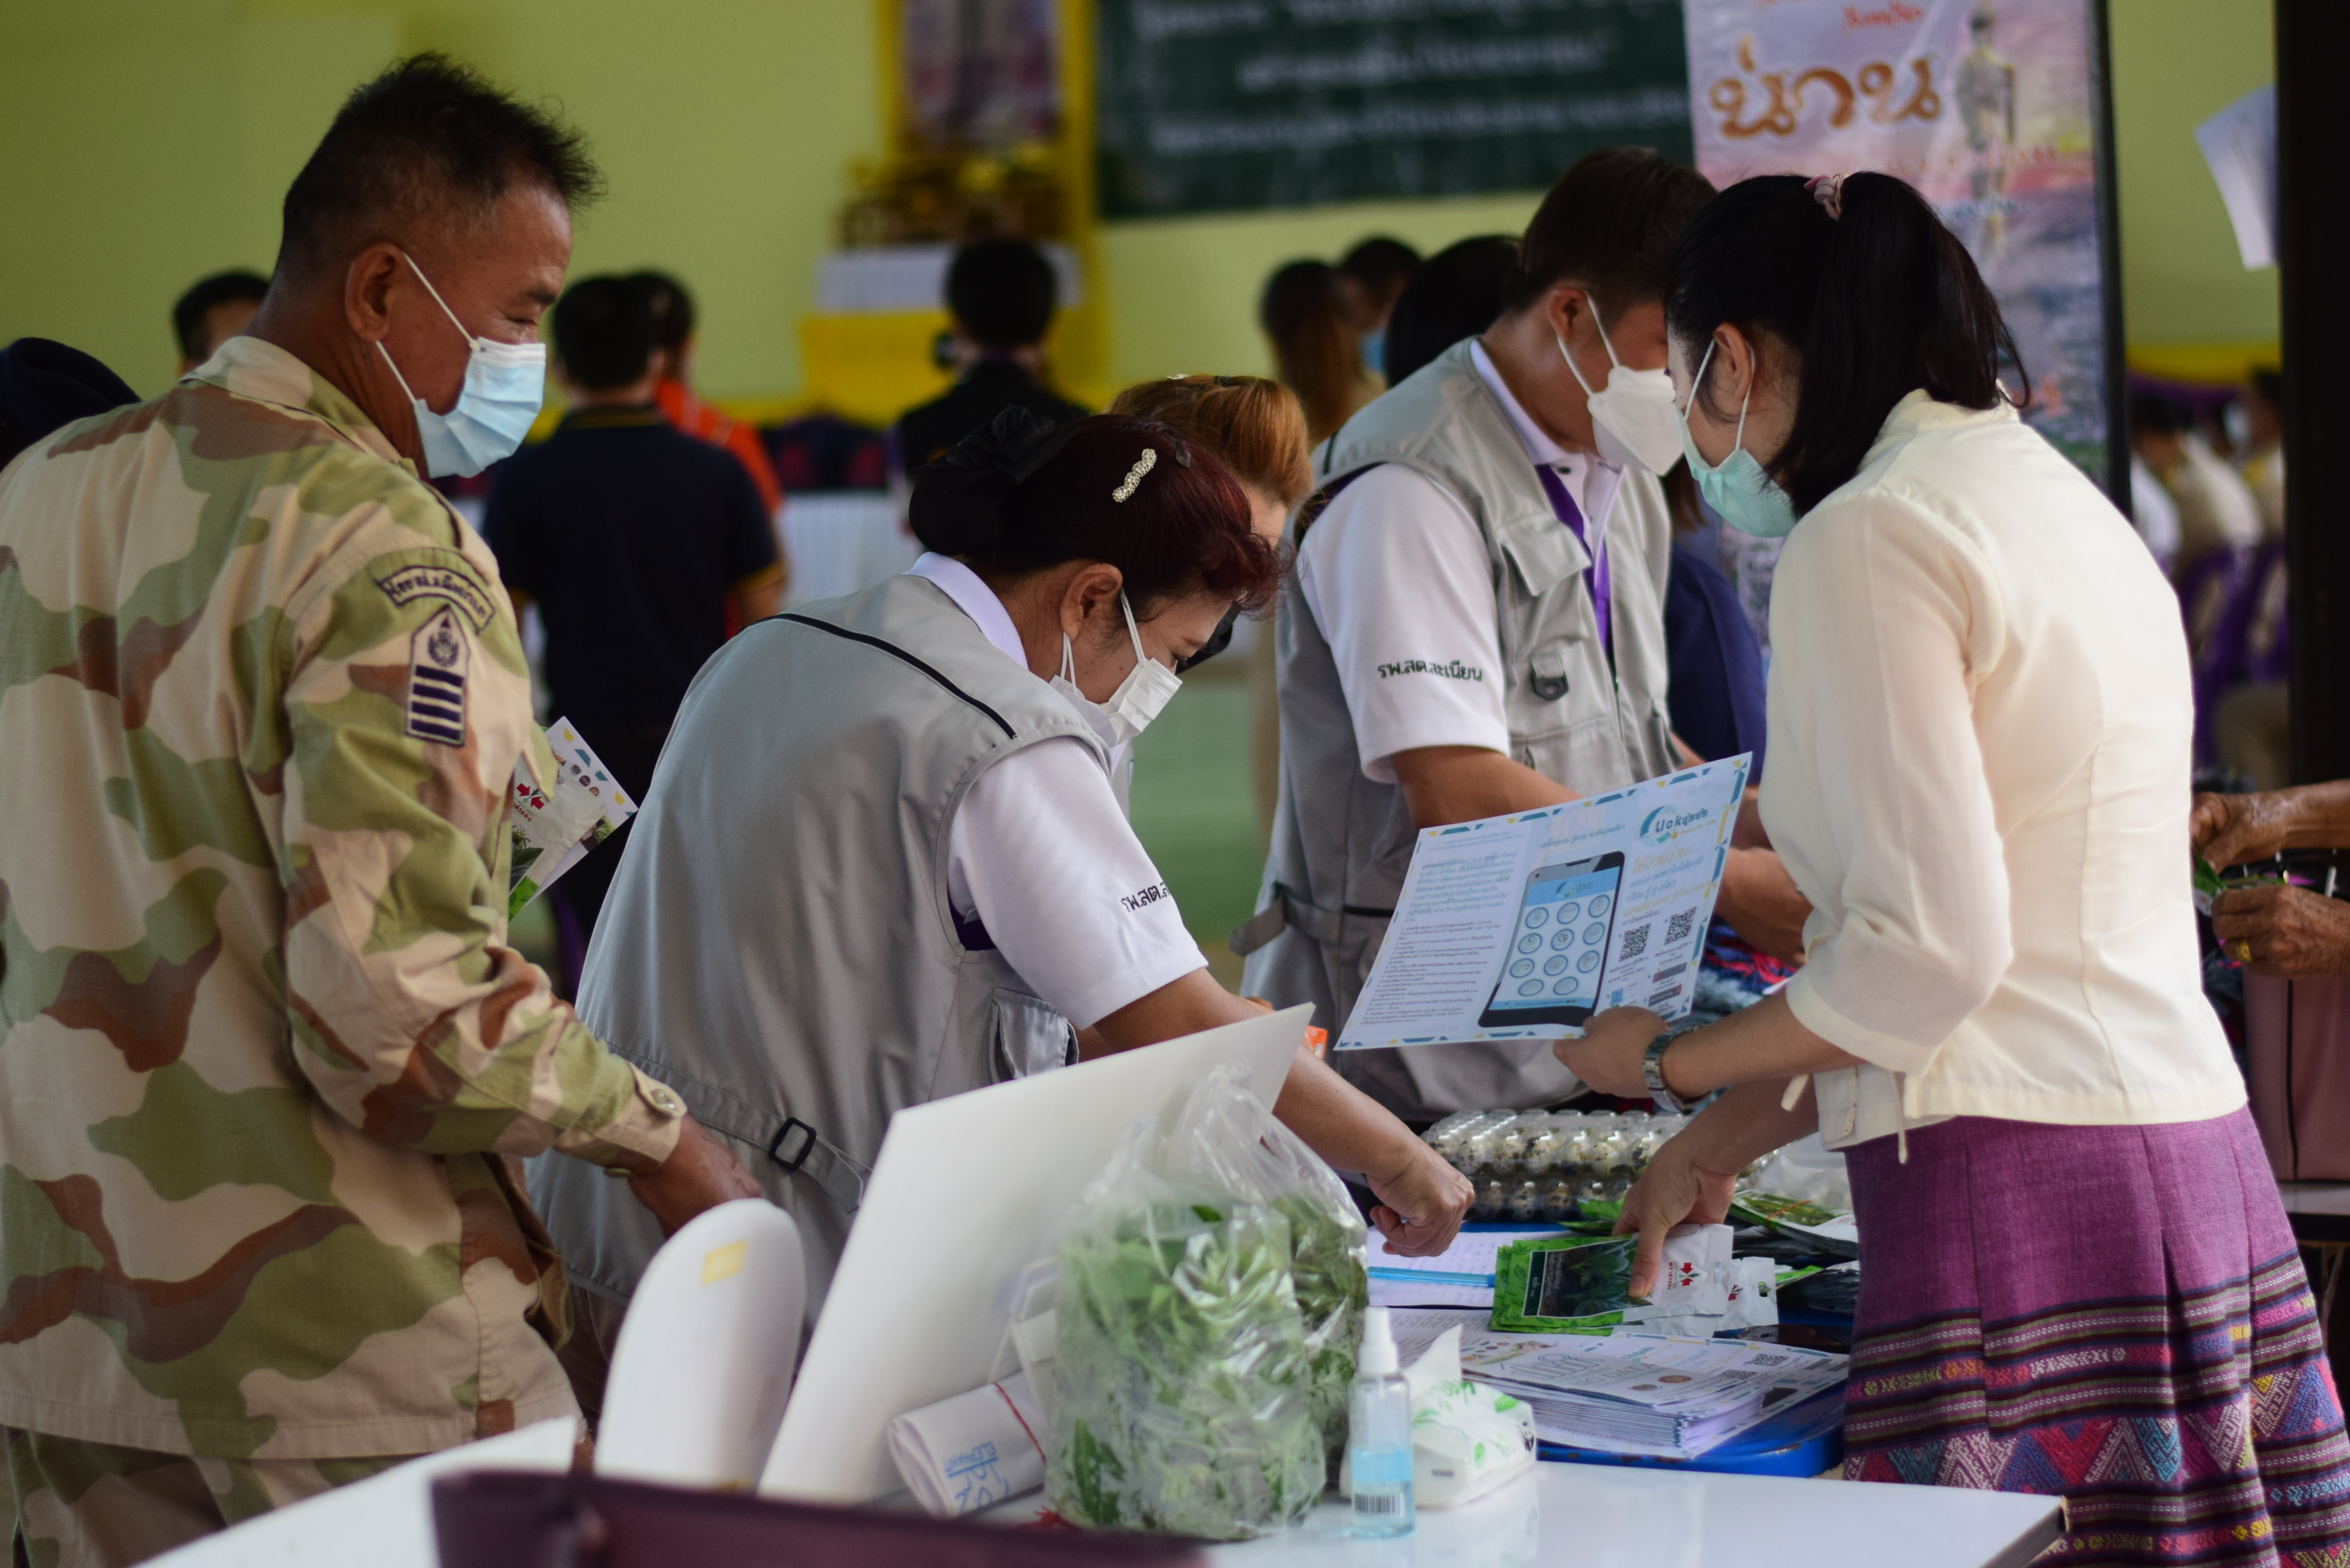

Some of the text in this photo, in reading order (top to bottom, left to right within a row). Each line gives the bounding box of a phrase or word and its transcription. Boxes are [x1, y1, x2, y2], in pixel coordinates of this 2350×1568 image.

[1710, 34, 1941, 138] น่าน
[1378, 660, 1483, 682] รพ.สต.สะเนียน
[1602, 1362, 1659, 1379] DATA
